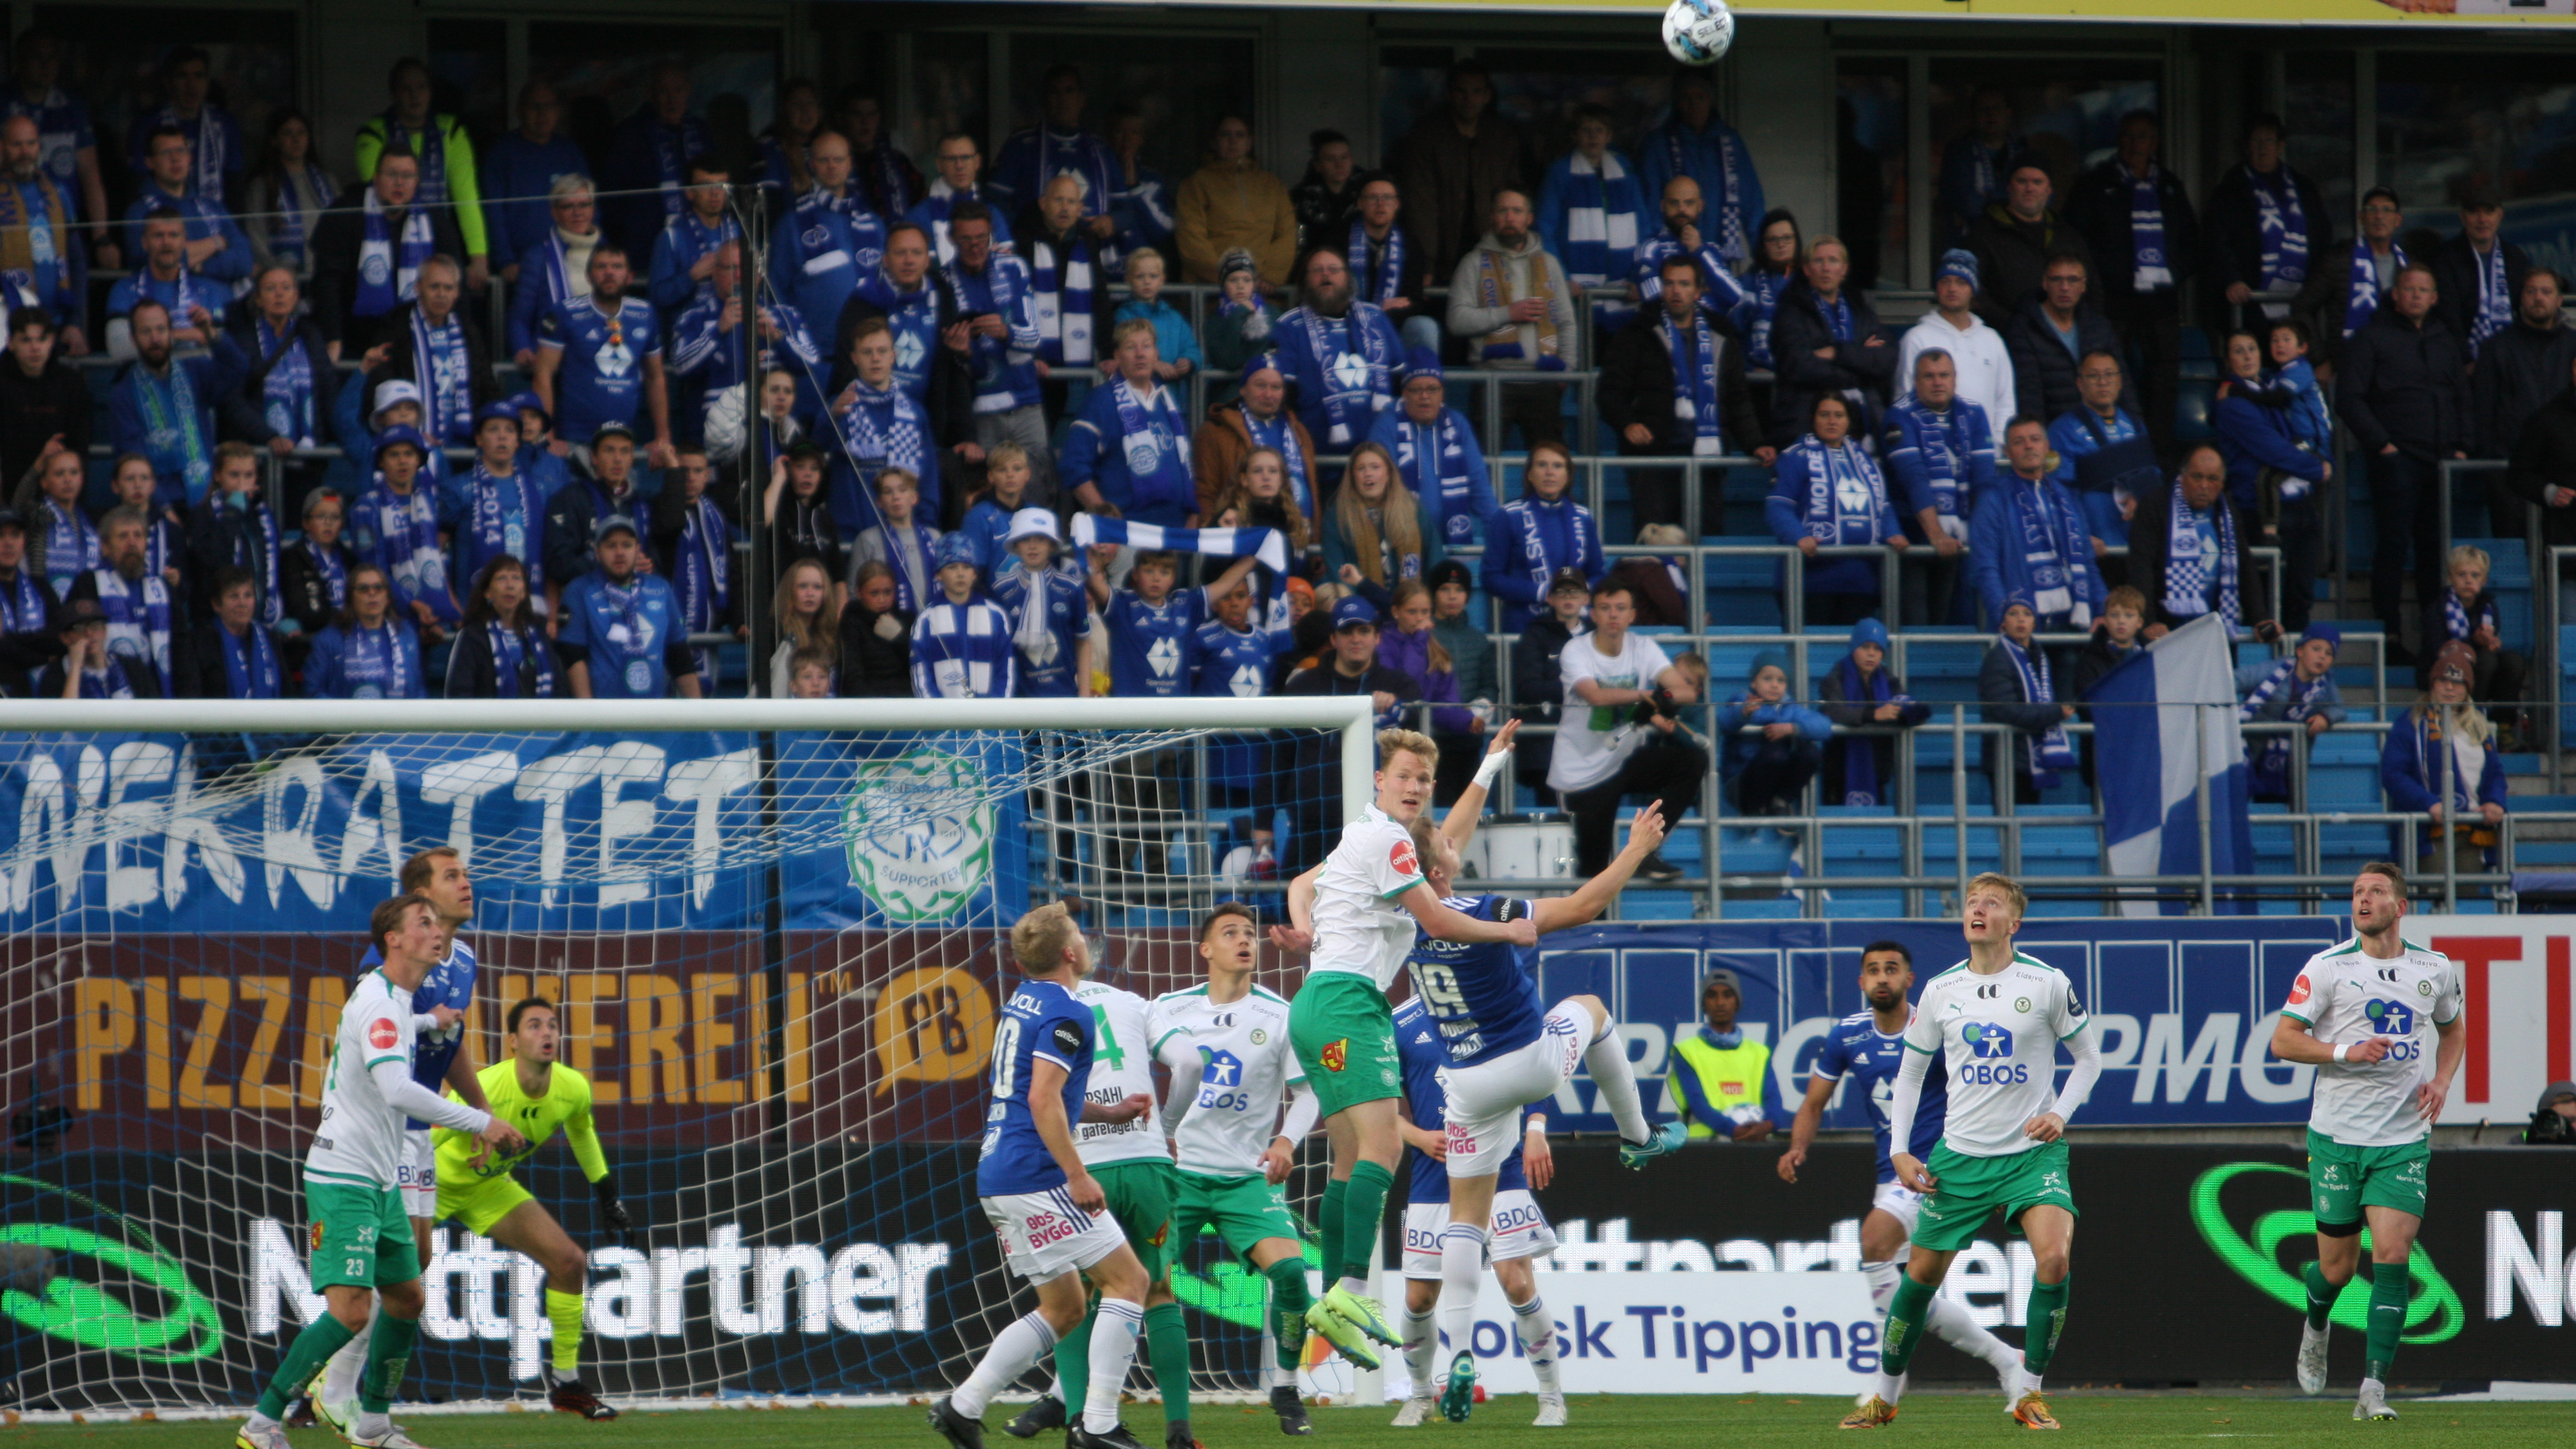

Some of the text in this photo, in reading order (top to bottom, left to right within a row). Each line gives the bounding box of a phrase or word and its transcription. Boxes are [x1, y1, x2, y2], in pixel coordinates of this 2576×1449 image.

[1809, 450, 1830, 515] MOLDE
[482, 486, 502, 545] 2014
[0, 740, 760, 913] NEKRATTET
[880, 865, 961, 888] SUPPORTER
[1408, 961, 1470, 1018] 19
[900, 985, 969, 1065] PB
[1054, 1028, 1081, 1047] altibox
[1962, 1063, 2028, 1085] OBOS
[1084, 1086, 1124, 1106] PSAHL
[1193, 1088, 1248, 1112] BOS
[1496, 1205, 1538, 1230] BDO
[1028, 1219, 1074, 1250] BYGG
[346, 1259, 364, 1277] 23
[249, 1219, 950, 1381] Nttpartner
[1625, 1305, 1879, 1373] Tipping
